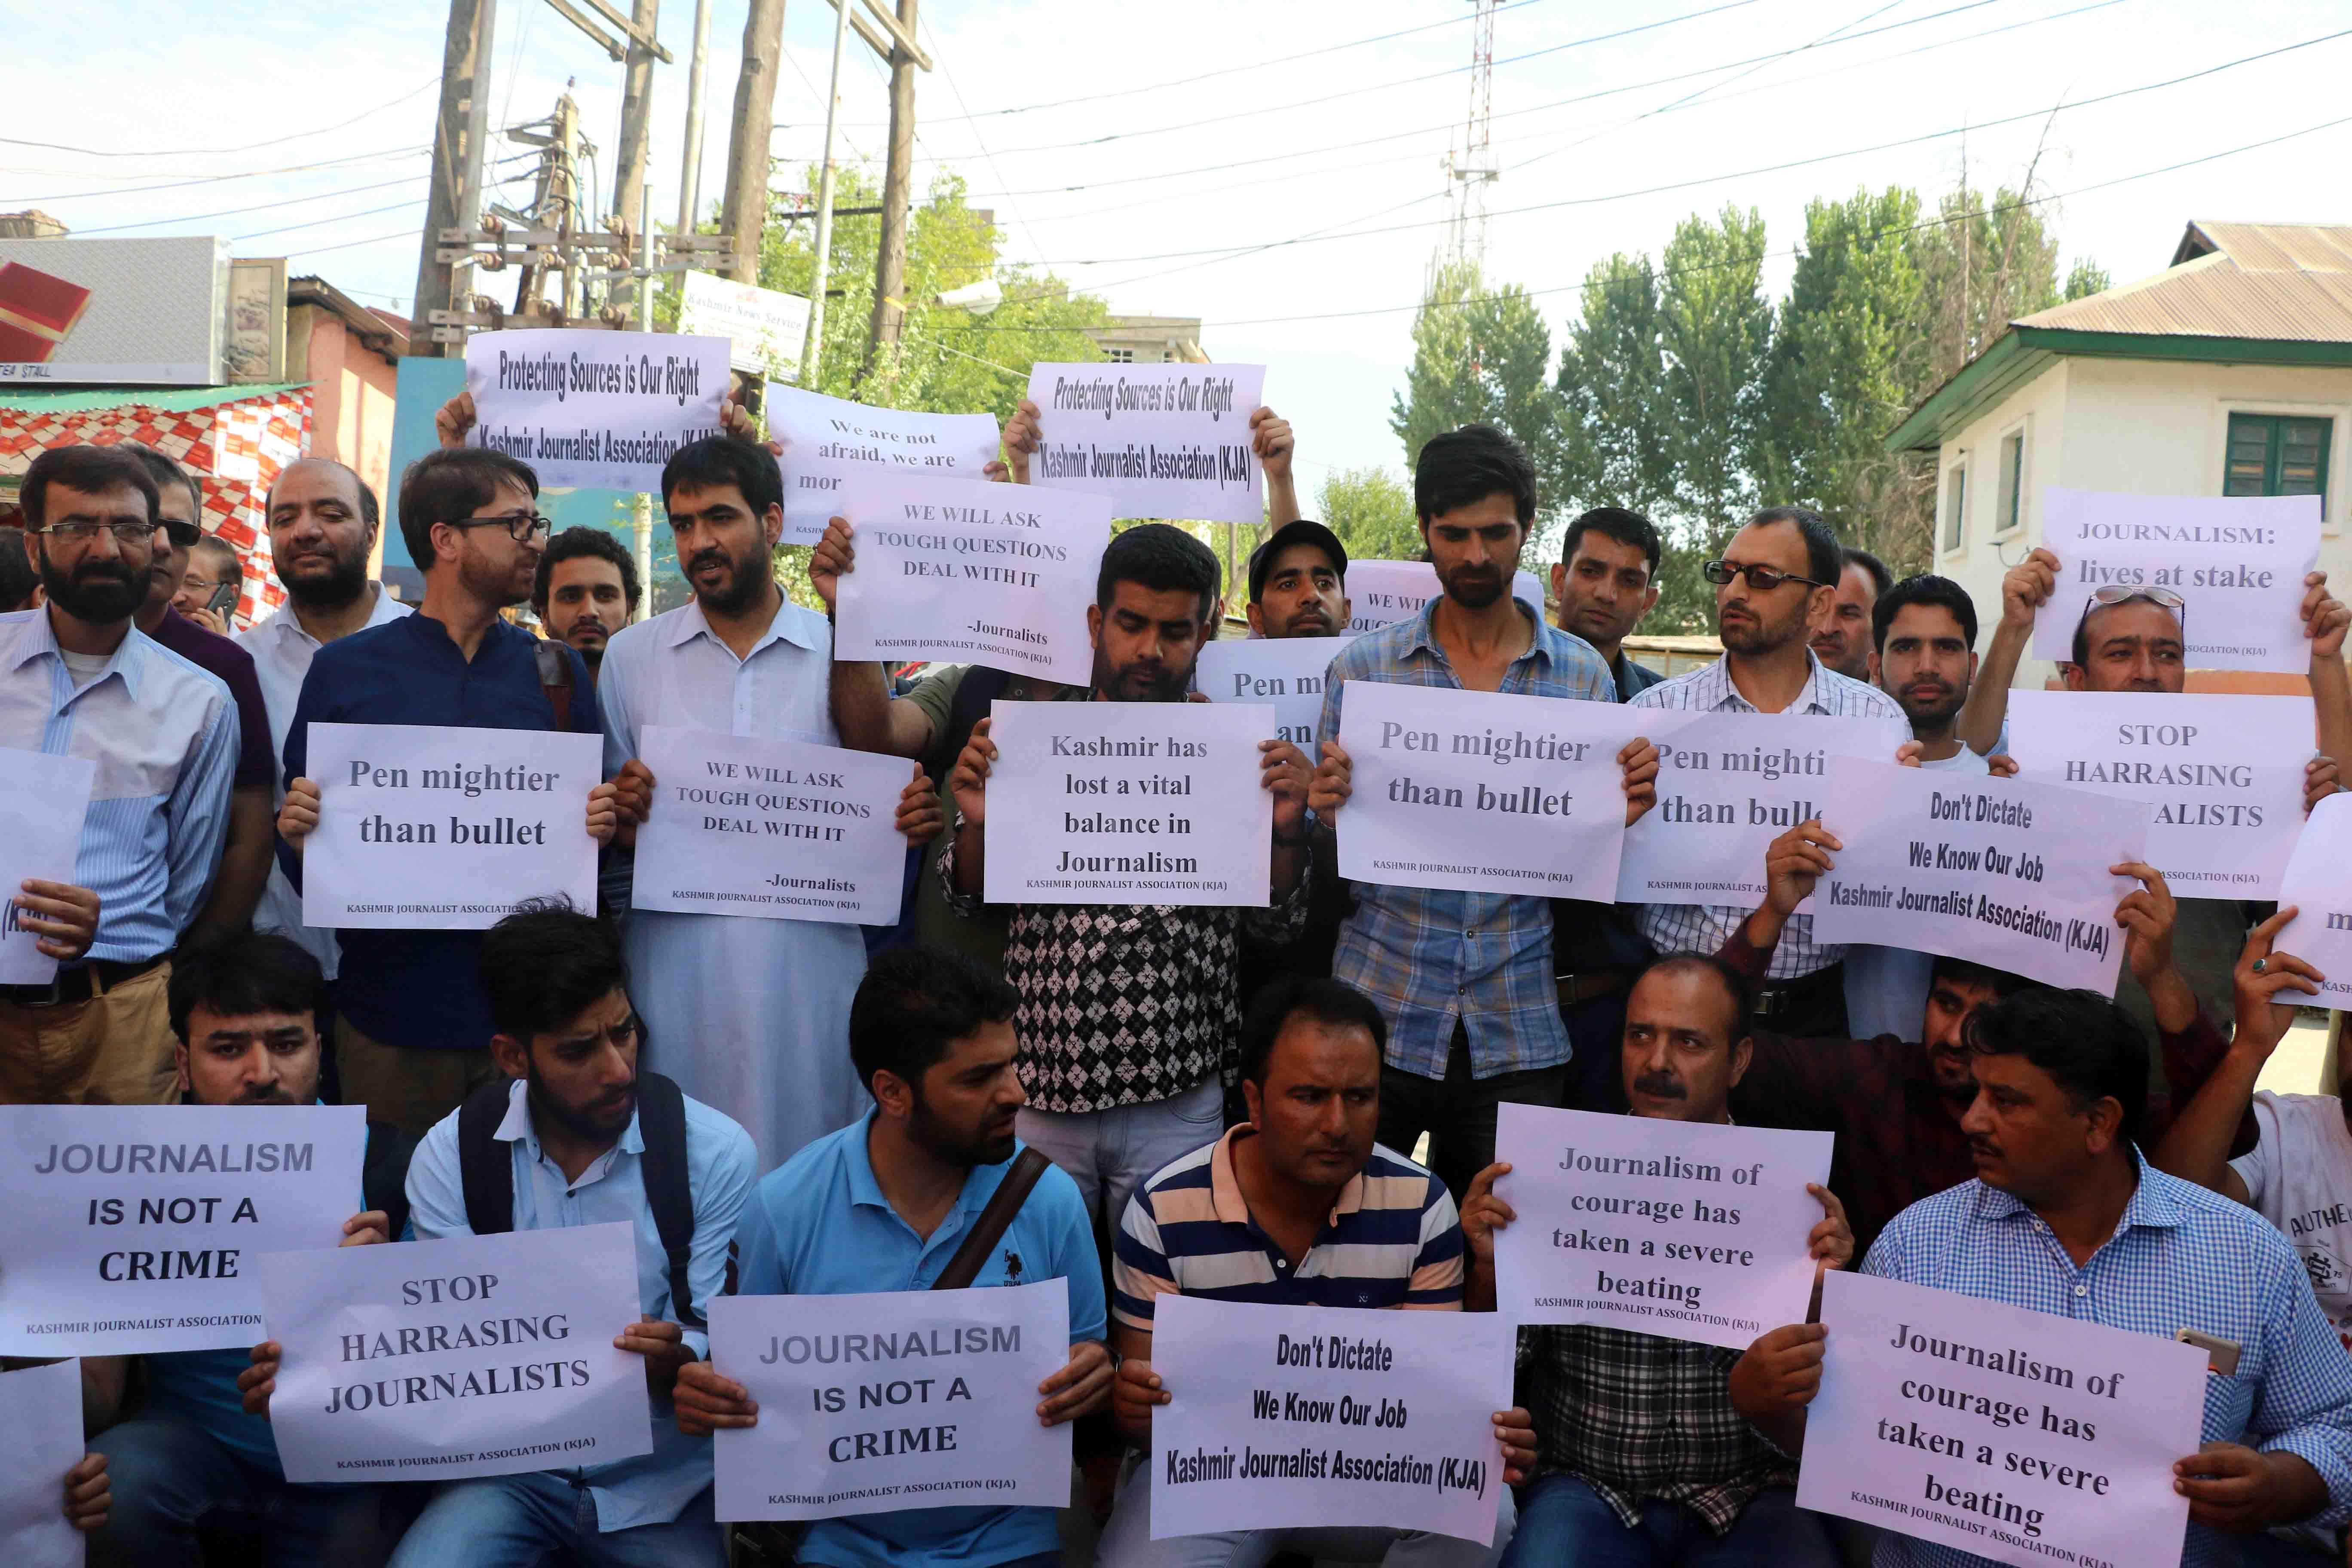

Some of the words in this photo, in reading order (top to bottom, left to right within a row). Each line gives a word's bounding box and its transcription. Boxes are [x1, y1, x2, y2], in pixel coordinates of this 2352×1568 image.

[688, 293, 732, 313] Kashmir
[738, 305, 760, 320] News
[766, 313, 801, 330] Service
[500, 351, 566, 402] Protecting
[570, 352, 620, 393] Sources
[625, 355, 635, 394] is
[640, 355, 662, 394] Our
[666, 356, 698, 406] Right
[1054, 377, 1113, 420] Protecting
[1115, 377, 1162, 410] Sources
[1165, 377, 1175, 411] is
[1178, 377, 1200, 411] Our
[1202, 377, 1233, 422] Right
[480, 425, 533, 458] Kashmir
[537, 427, 600, 462] Journalist
[604, 430, 676, 464] Association
[830, 420, 863, 435] We
[870, 430, 899, 442] are
[906, 434, 935, 444] not
[819, 442, 885, 465] afraid,
[892, 454, 917, 465] we
[925, 456, 955, 467] are
[1040, 443, 1087, 478] Kashmir
[1091, 444, 1147, 478] Journalist
[1151, 444, 1216, 480] Association
[1219, 445, 1250, 492] (KJA)
[799, 476, 841, 490] mor
[904, 505, 934, 520] WE
[942, 507, 994, 524] WILL
[1001, 512, 1042, 528] ASK
[875, 532, 947, 550] TOUGH
[953, 537, 1066, 560] QUESTIONS
[2078, 524, 2274, 544] JOURNALISM:
[904, 561, 957, 577] DEAL
[964, 566, 1015, 584] WITH
[1022, 572, 1039, 587] IT
[2079, 560, 2143, 585] lives
[2155, 565, 2182, 585] at
[2194, 565, 2272, 588] stake
[968, 621, 1047, 645] -Journalists
[1233, 674, 1286, 696] Pen
[1052, 736, 1158, 756] Kashmir
[1167, 737, 1207, 757] has
[1379, 722, 1439, 752] Pen
[1451, 729, 1590, 764] mightier
[2119, 725, 2197, 746] STOP
[707, 762, 738, 778] WE
[745, 766, 798, 784] WILL
[803, 772, 844, 788] ASK
[1657, 744, 1709, 769] Pen
[1721, 747, 1824, 780] mighti
[2065, 761, 2252, 787] HARRASING
[349, 761, 409, 787] Pen
[422, 763, 559, 797] mightier
[1066, 774, 1109, 794] lost
[1118, 781, 1129, 794] a
[1138, 775, 1191, 794] vital
[677, 787, 750, 806] TOUGH
[756, 794, 870, 818] QUESTIONS
[1389, 778, 1463, 808] than
[1477, 784, 1572, 816] bullet
[1661, 796, 1735, 824] than
[1931, 792, 1971, 821] Don't
[1975, 795, 2031, 828] Dictate
[360, 815, 437, 842] than
[450, 817, 545, 845] bullet
[704, 817, 757, 833] DEAL
[764, 822, 818, 839] WITH
[825, 828, 845, 841] IT
[1065, 812, 1160, 833] balance
[1168, 813, 1190, 833] in
[2154, 804, 2262, 827] ALISTS
[1057, 851, 1197, 873] Journalism
[1374, 861, 1417, 871] KASHMIR
[1419, 864, 1478, 874] JOURNALIST
[1480, 867, 1545, 879] ASSOCIATION
[1548, 873, 1572, 883] (KJA)
[1910, 842, 1932, 867] We
[1936, 843, 1981, 870] Know
[1985, 846, 2012, 875] Our
[2015, 853, 2043, 882] Job
[766, 874, 855, 892] -Journalists
[1075, 880, 1133, 889] JOURNALIST
[1203, 882, 1227, 891] (KJA)
[397, 905, 457, 914] JOURNALIST
[673, 891, 715, 900] KASHMIR
[717, 893, 773, 903] JOURNALIST
[775, 897, 834, 907] ASSOCIATION
[837, 901, 860, 910] (KJA)
[1831, 882, 1893, 908] Kashmir
[1896, 887, 1973, 918] Journalist
[1976, 895, 2062, 942] Association
[2066, 919, 2109, 962] (KJA)
[35, 1143, 313, 1173] JOURNALISM
[1559, 1148, 1721, 1182] Journalism
[1732, 1164, 1763, 1185] of
[89, 1199, 124, 1225] IS
[139, 1198, 221, 1224] NOT
[231, 1198, 258, 1222] A
[1571, 1196, 1684, 1223] courage
[1694, 1200, 1740, 1224] has
[2291, 1204, 2352, 1237] AUTHE
[1553, 1228, 1629, 1253] taken
[1641, 1241, 1654, 1256] a
[1666, 1243, 1753, 1266] severe
[100, 1250, 239, 1281] CRIME
[403, 1275, 498, 1305] STOP
[1598, 1271, 1701, 1311] beating
[28, 1323, 89, 1333] KASHMIR
[94, 1318, 174, 1333] JOURNALIST
[177, 1315, 261, 1327] ASSOCIATION
[1535, 1298, 1583, 1308] KASHMIR
[1587, 1301, 1654, 1315] JOURNALIST
[1656, 1308, 1729, 1326] ASSOCIATION
[1732, 1319, 1759, 1332] (KJA)
[340, 1314, 569, 1362] HARRASING
[760, 1326, 1020, 1364] JOURNALISM
[1277, 1334, 1323, 1368] Don't
[1328, 1336, 1392, 1371] Dictate
[1891, 1324, 2073, 1388] Journalism
[2087, 1373, 2124, 1399] of
[325, 1360, 589, 1413] JOURNALISTS
[814, 1388, 845, 1412] IS
[860, 1379, 935, 1409] NOT
[946, 1378, 972, 1401] A
[1254, 1390, 1279, 1420] We
[1285, 1393, 1335, 1423] Know
[1340, 1396, 1371, 1425] Our
[1375, 1398, 1406, 1428] Job
[1902, 1381, 2028, 1427] courage
[2040, 1406, 2095, 1441] has
[829, 1425, 956, 1462] CRIME
[1878, 1418, 1963, 1458] taken
[1976, 1446, 1992, 1465] a
[2005, 1453, 2108, 1495] severe
[1167, 1446, 1235, 1485] Kashmir
[1240, 1446, 1327, 1479] Journalist
[1331, 1450, 1433, 1485] Association
[1438, 1457, 1485, 1500] (KJA)
[769, 1495, 825, 1504] KASHMIR
[828, 1486, 900, 1505] JOURNALIST
[903, 1480, 982, 1493] ASSOCIATION
[986, 1480, 1015, 1489] (KJA)
[1925, 1474, 2044, 1539] beating
